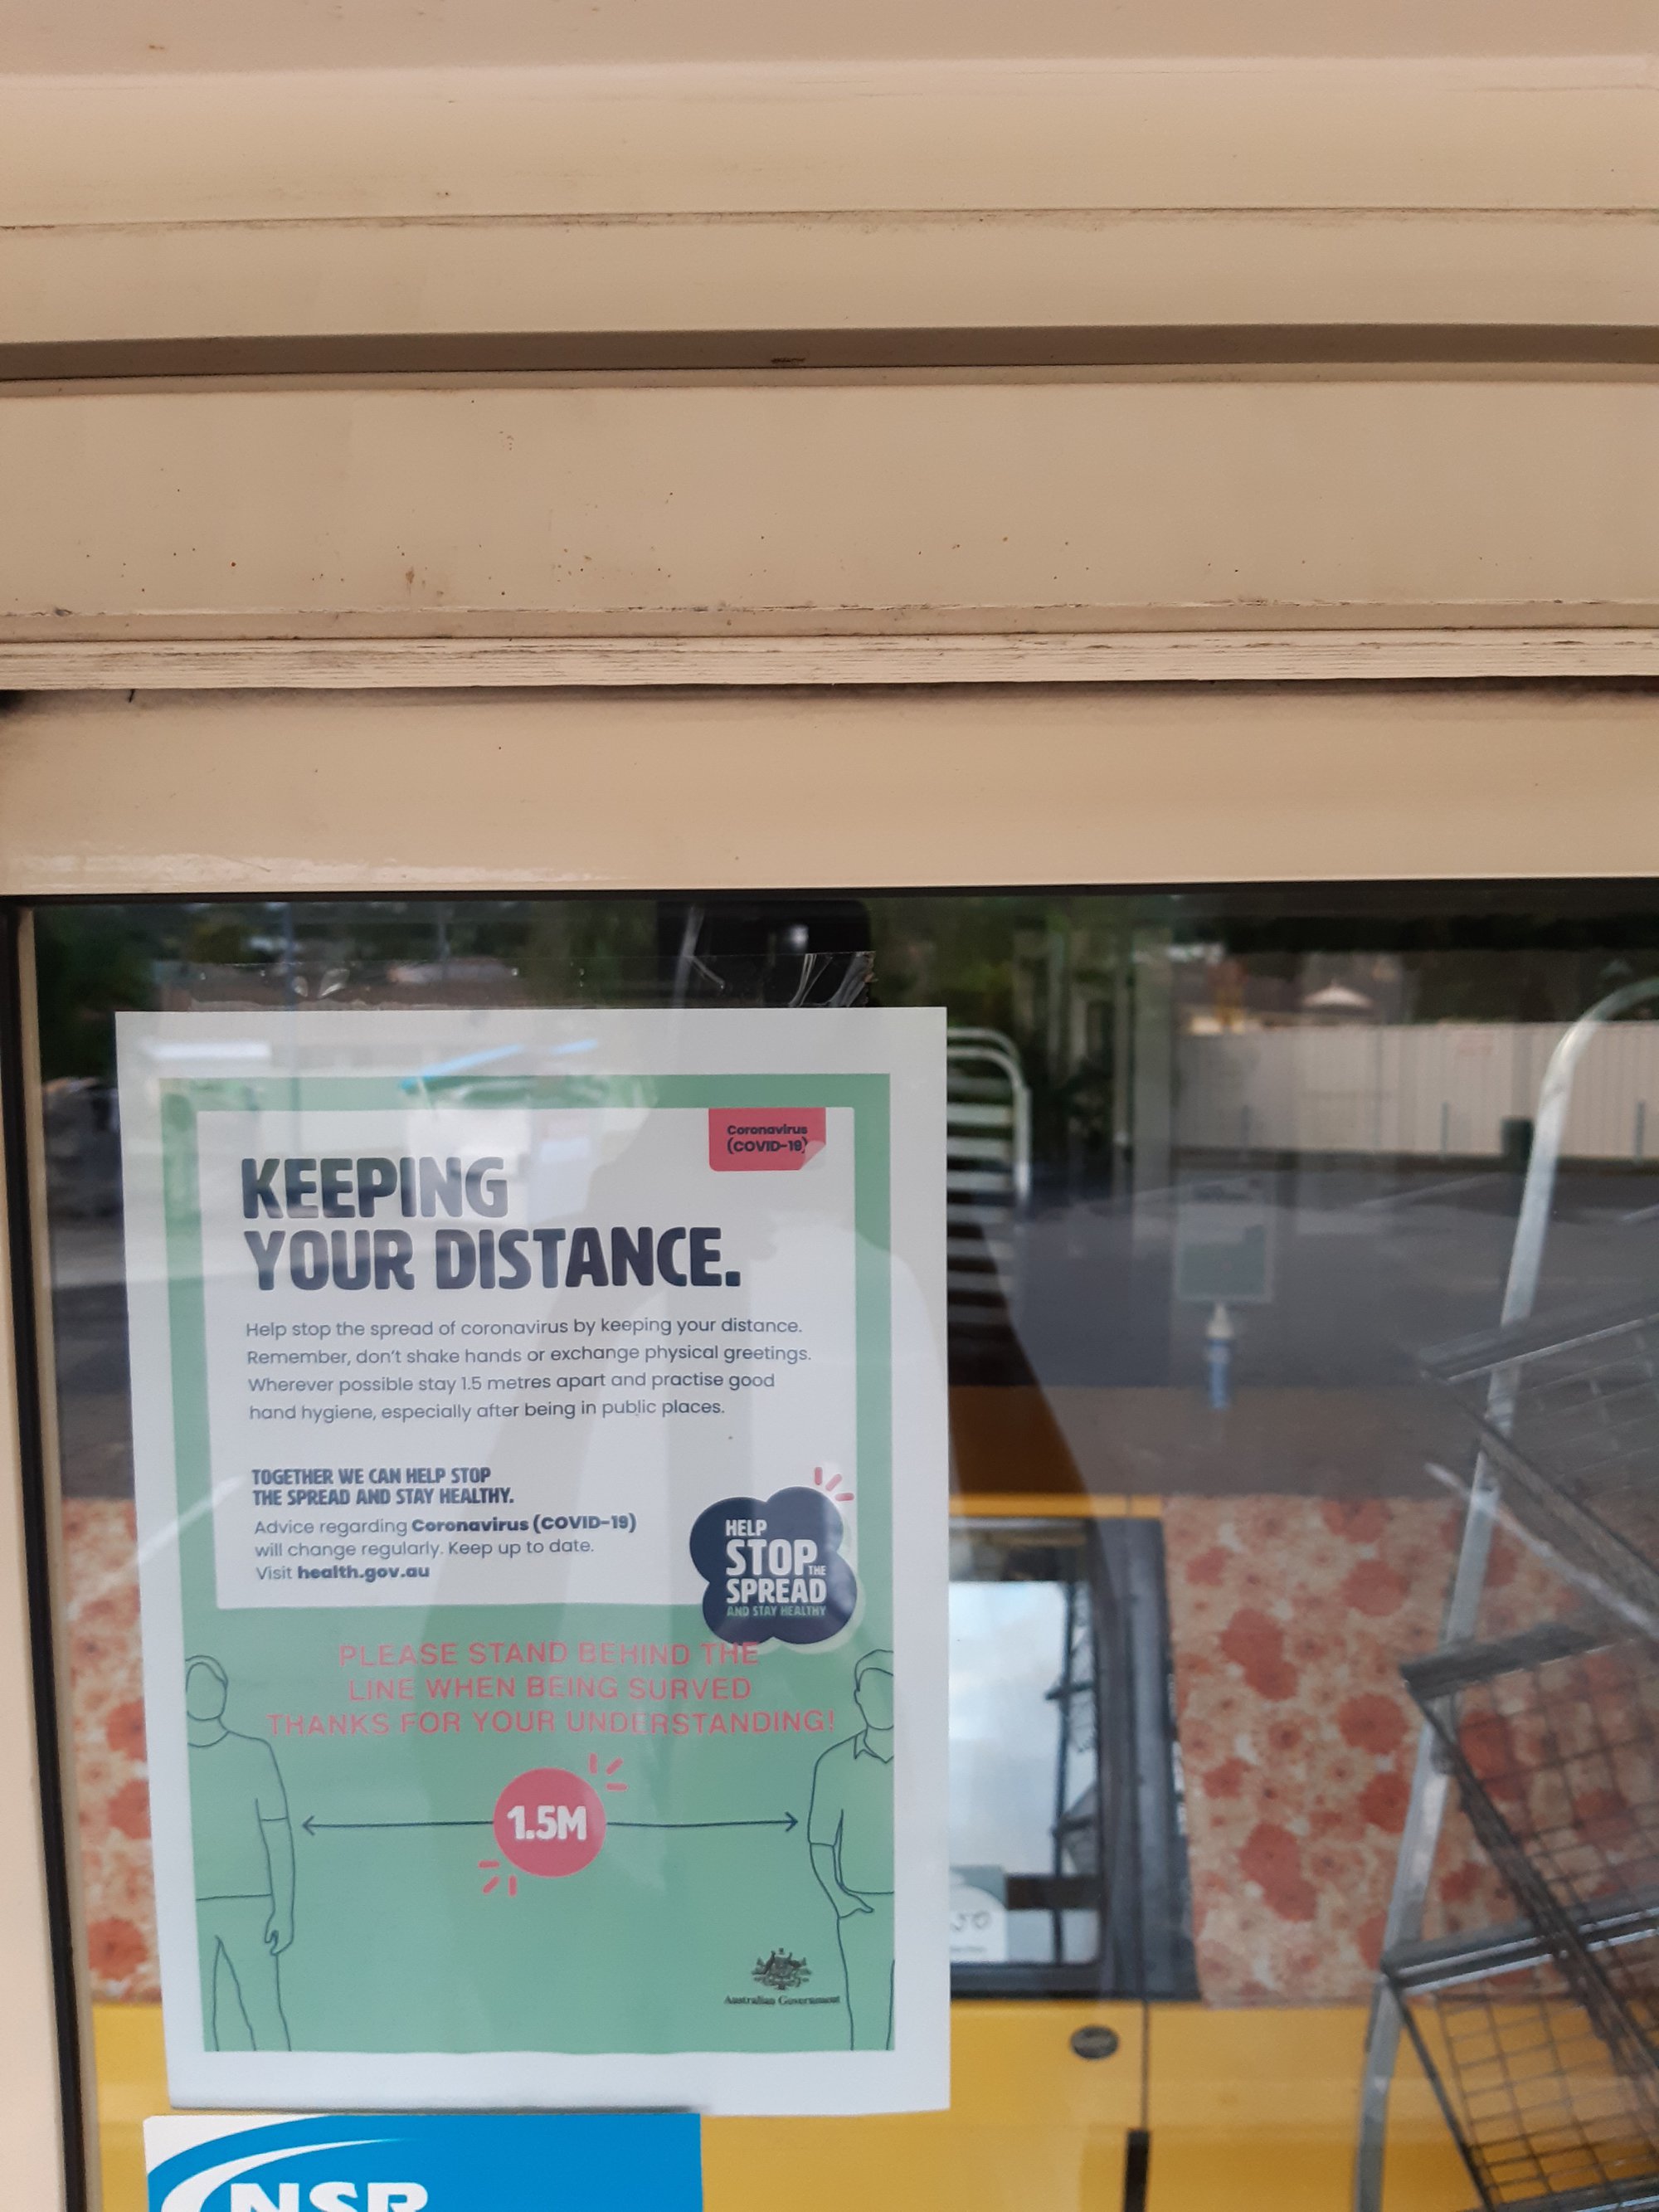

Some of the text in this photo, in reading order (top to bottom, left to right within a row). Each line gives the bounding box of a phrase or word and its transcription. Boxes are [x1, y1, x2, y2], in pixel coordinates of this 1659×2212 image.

[727, 1123, 808, 1135] Coronavirus
[241, 1157, 508, 1219] KEEPING
[244, 1226, 741, 1290] YOUR DISTANCE.
[246, 1318, 802, 1341] Help stop the spread of coronavirus by keeping your distance.
[248, 1350, 351, 1366] Remember,
[406, 1348, 460, 1363] shake
[465, 1348, 521, 1362] hands
[527, 1350, 545, 1362] or
[550, 1347, 640, 1362] exchange
[645, 1345, 718, 1362] physical
[723, 1345, 812, 1365] greetings.
[248, 1372, 775, 1395] Wherever possible stay 1.5 metres apart and practise good
[249, 1399, 724, 1423] hand hygiene, especially after being in public places.
[252, 1467, 491, 1484] TOGETHER WE CAN HELP STOP
[252, 1487, 514, 1505] THE SPREAD AND STAY HEALTHY.
[255, 1513, 637, 1537] Advice regarding Coronavirus (COVID-19)
[725, 1519, 767, 1536] HELP
[255, 1538, 594, 1560] will change regularly. Keep up to date.
[726, 1538, 826, 1576] STOP THE
[255, 1565, 431, 1582] Visit health.gov.au
[726, 1578, 827, 1603] SPREAD
[727, 1605, 827, 1616] AND STAY HEALTHY
[339, 1641, 758, 1666] PLEASE STAND BEHIND THE
[349, 1676, 752, 1701] LINE WHEN BEING SURVED
[266, 1709, 834, 1736] THANKS FOR YOUR UNDERSTANDING!
[507, 1805, 587, 1840] 1.5M
[725, 1995, 841, 2005] Australian Government
